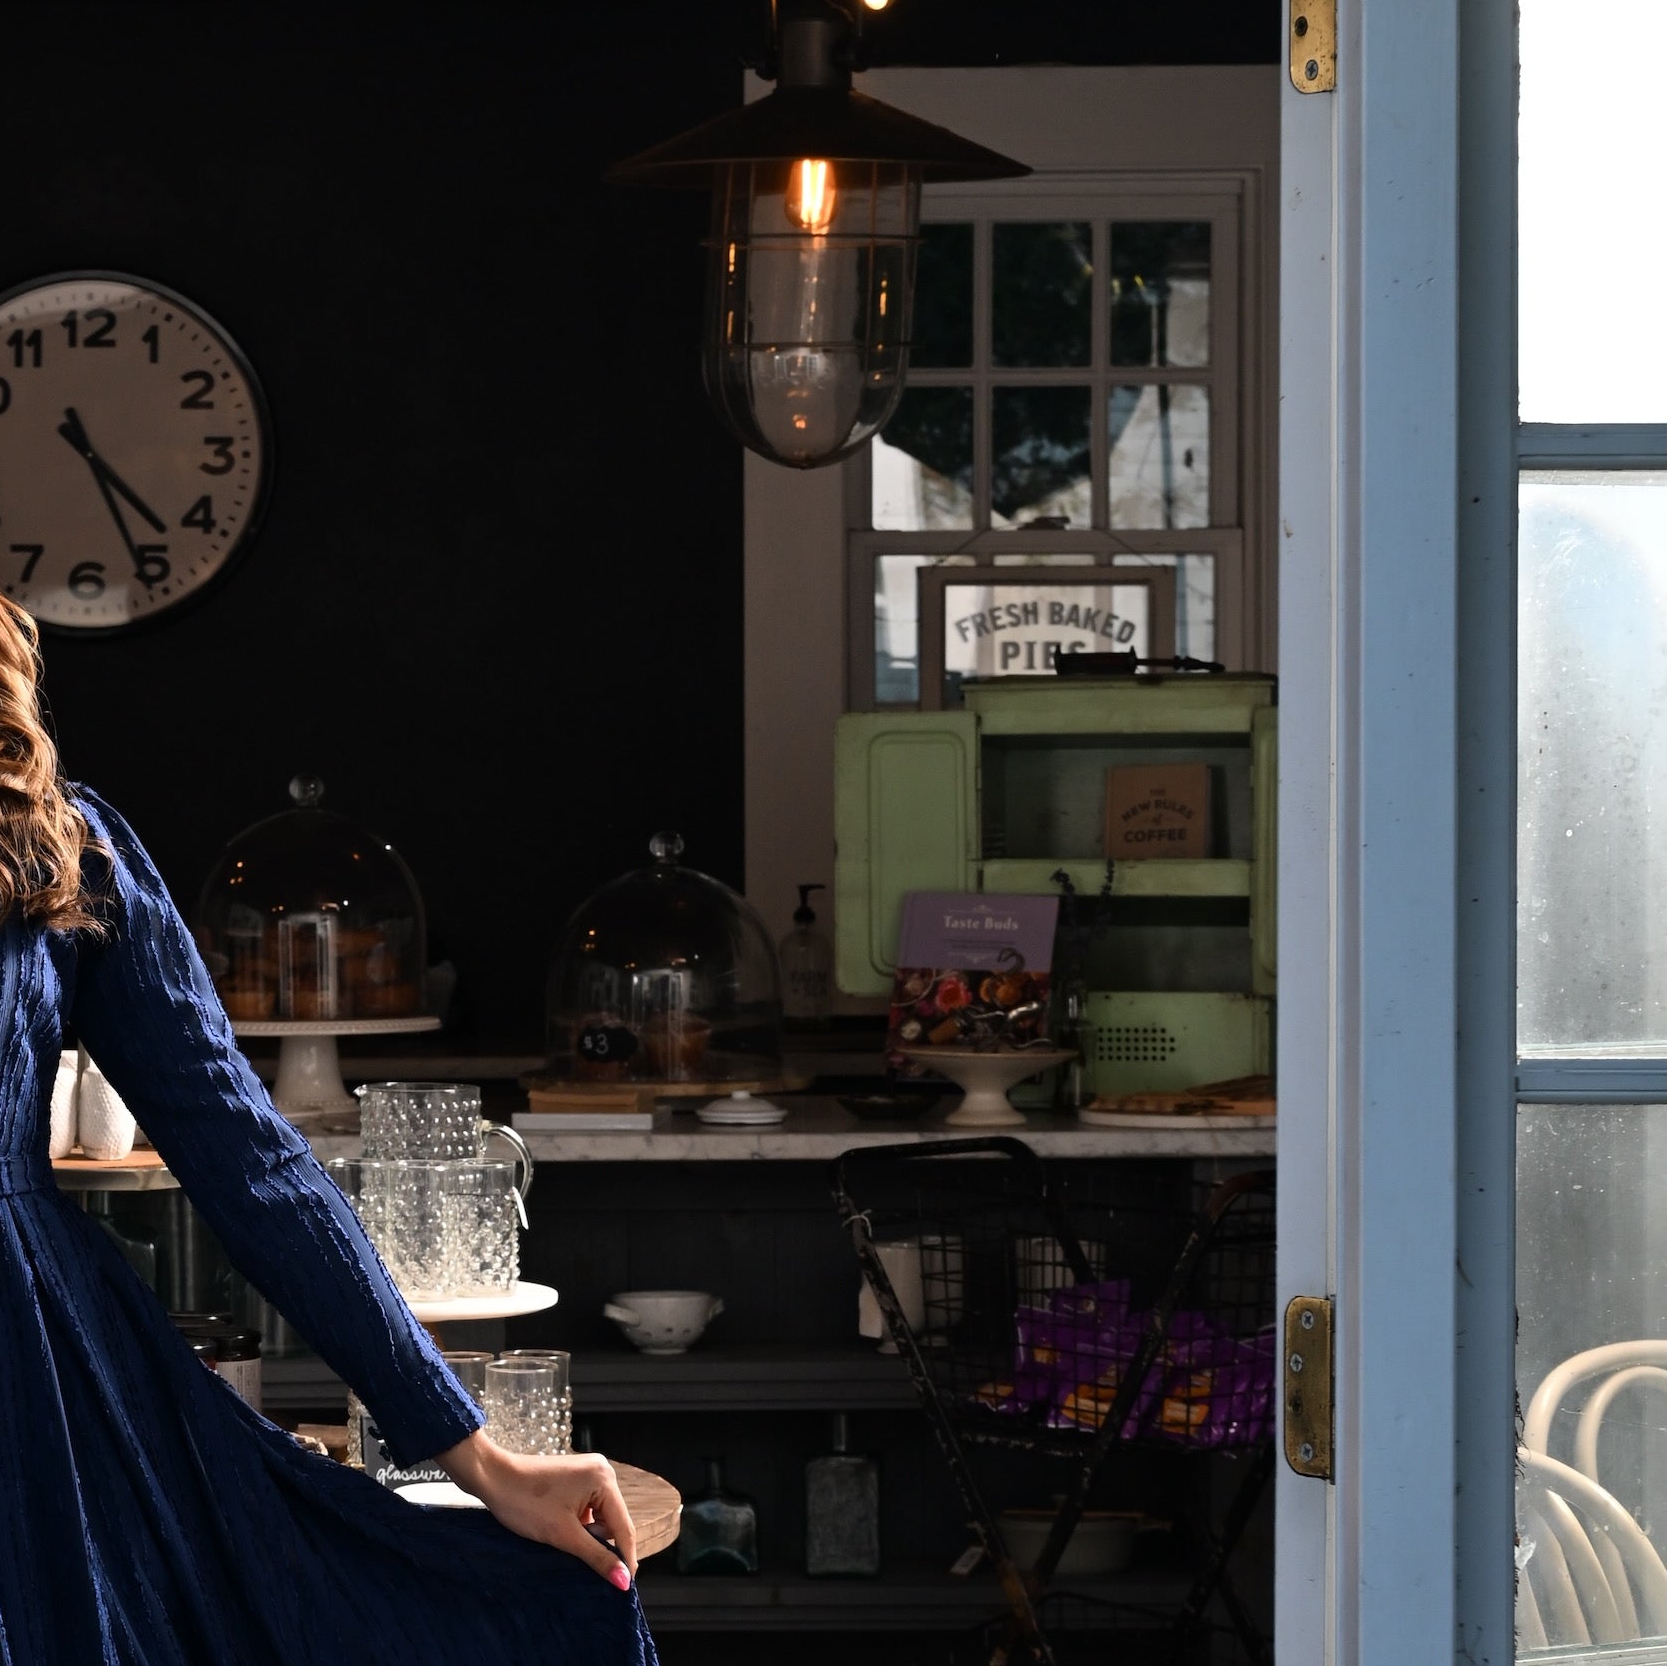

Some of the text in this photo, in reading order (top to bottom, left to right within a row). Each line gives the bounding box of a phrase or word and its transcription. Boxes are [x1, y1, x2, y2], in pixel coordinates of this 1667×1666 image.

[6, 328, 43, 369] 11
[60, 308, 118, 349] 12
[141, 324, 159, 365] 1
[179, 369, 215, 411] 2
[199, 435, 235, 476] 3
[180, 494, 217, 534] 4
[9, 544, 45, 584] 7
[67, 561, 106, 601] 6
[136, 544, 171, 587] 5
[954, 600, 1137, 644] FRESH BAKED
[1121, 798, 1194, 822] NEW RULES
[1123, 827, 1188, 843] COFFEE
[943, 914, 1020, 931] Taste Buds
[583, 1033, 610, 1055] $3
